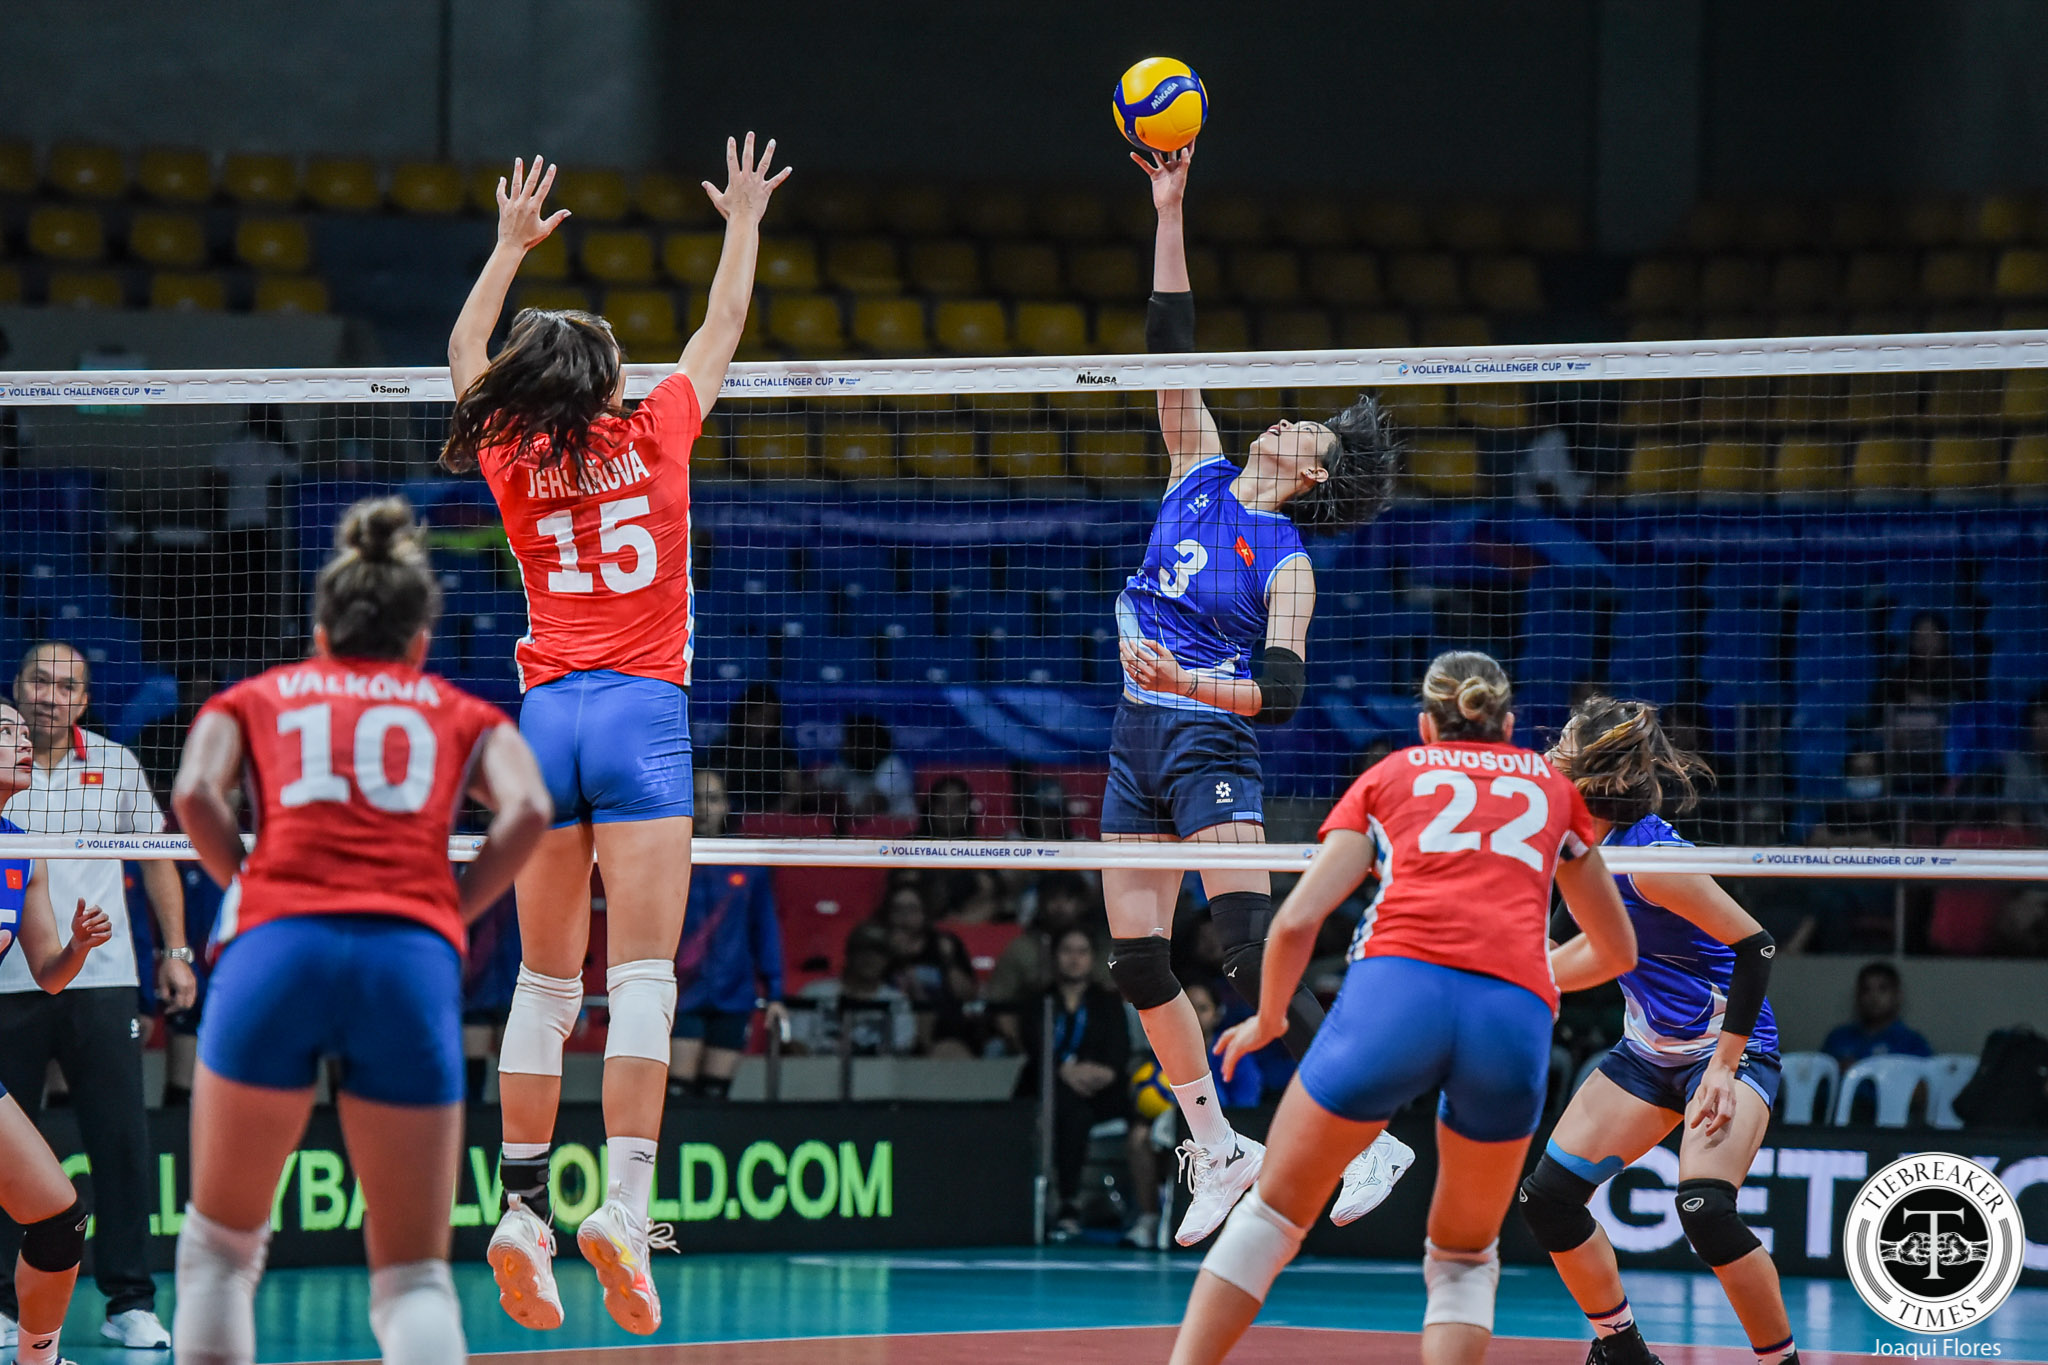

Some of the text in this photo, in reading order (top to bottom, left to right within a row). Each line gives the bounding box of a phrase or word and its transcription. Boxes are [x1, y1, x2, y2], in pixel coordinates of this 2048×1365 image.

[1412, 362, 1562, 374] VOLLEYBALL CHALLENGER CUP
[721, 377, 834, 387] YBALL CHALLENGER CUP
[8, 387, 140, 397] VOLLEYBALL CHALLENGER CUP
[380, 385, 410, 394] Senoh
[536, 495, 658, 594] 15
[1158, 538, 1209, 599] 3
[276, 702, 438, 814] 10
[1412, 769, 1549, 873] 22
[87, 840, 195, 849] VOLLEYBALL CHALLENGE
[891, 847, 948, 857] VOLLEYBALL
[950, 847, 1011, 857] CHALLENGER
[1013, 848, 1033, 857] CUP
[1767, 855, 1926, 866] VOLLEYBALL CHALLENGER CUP
